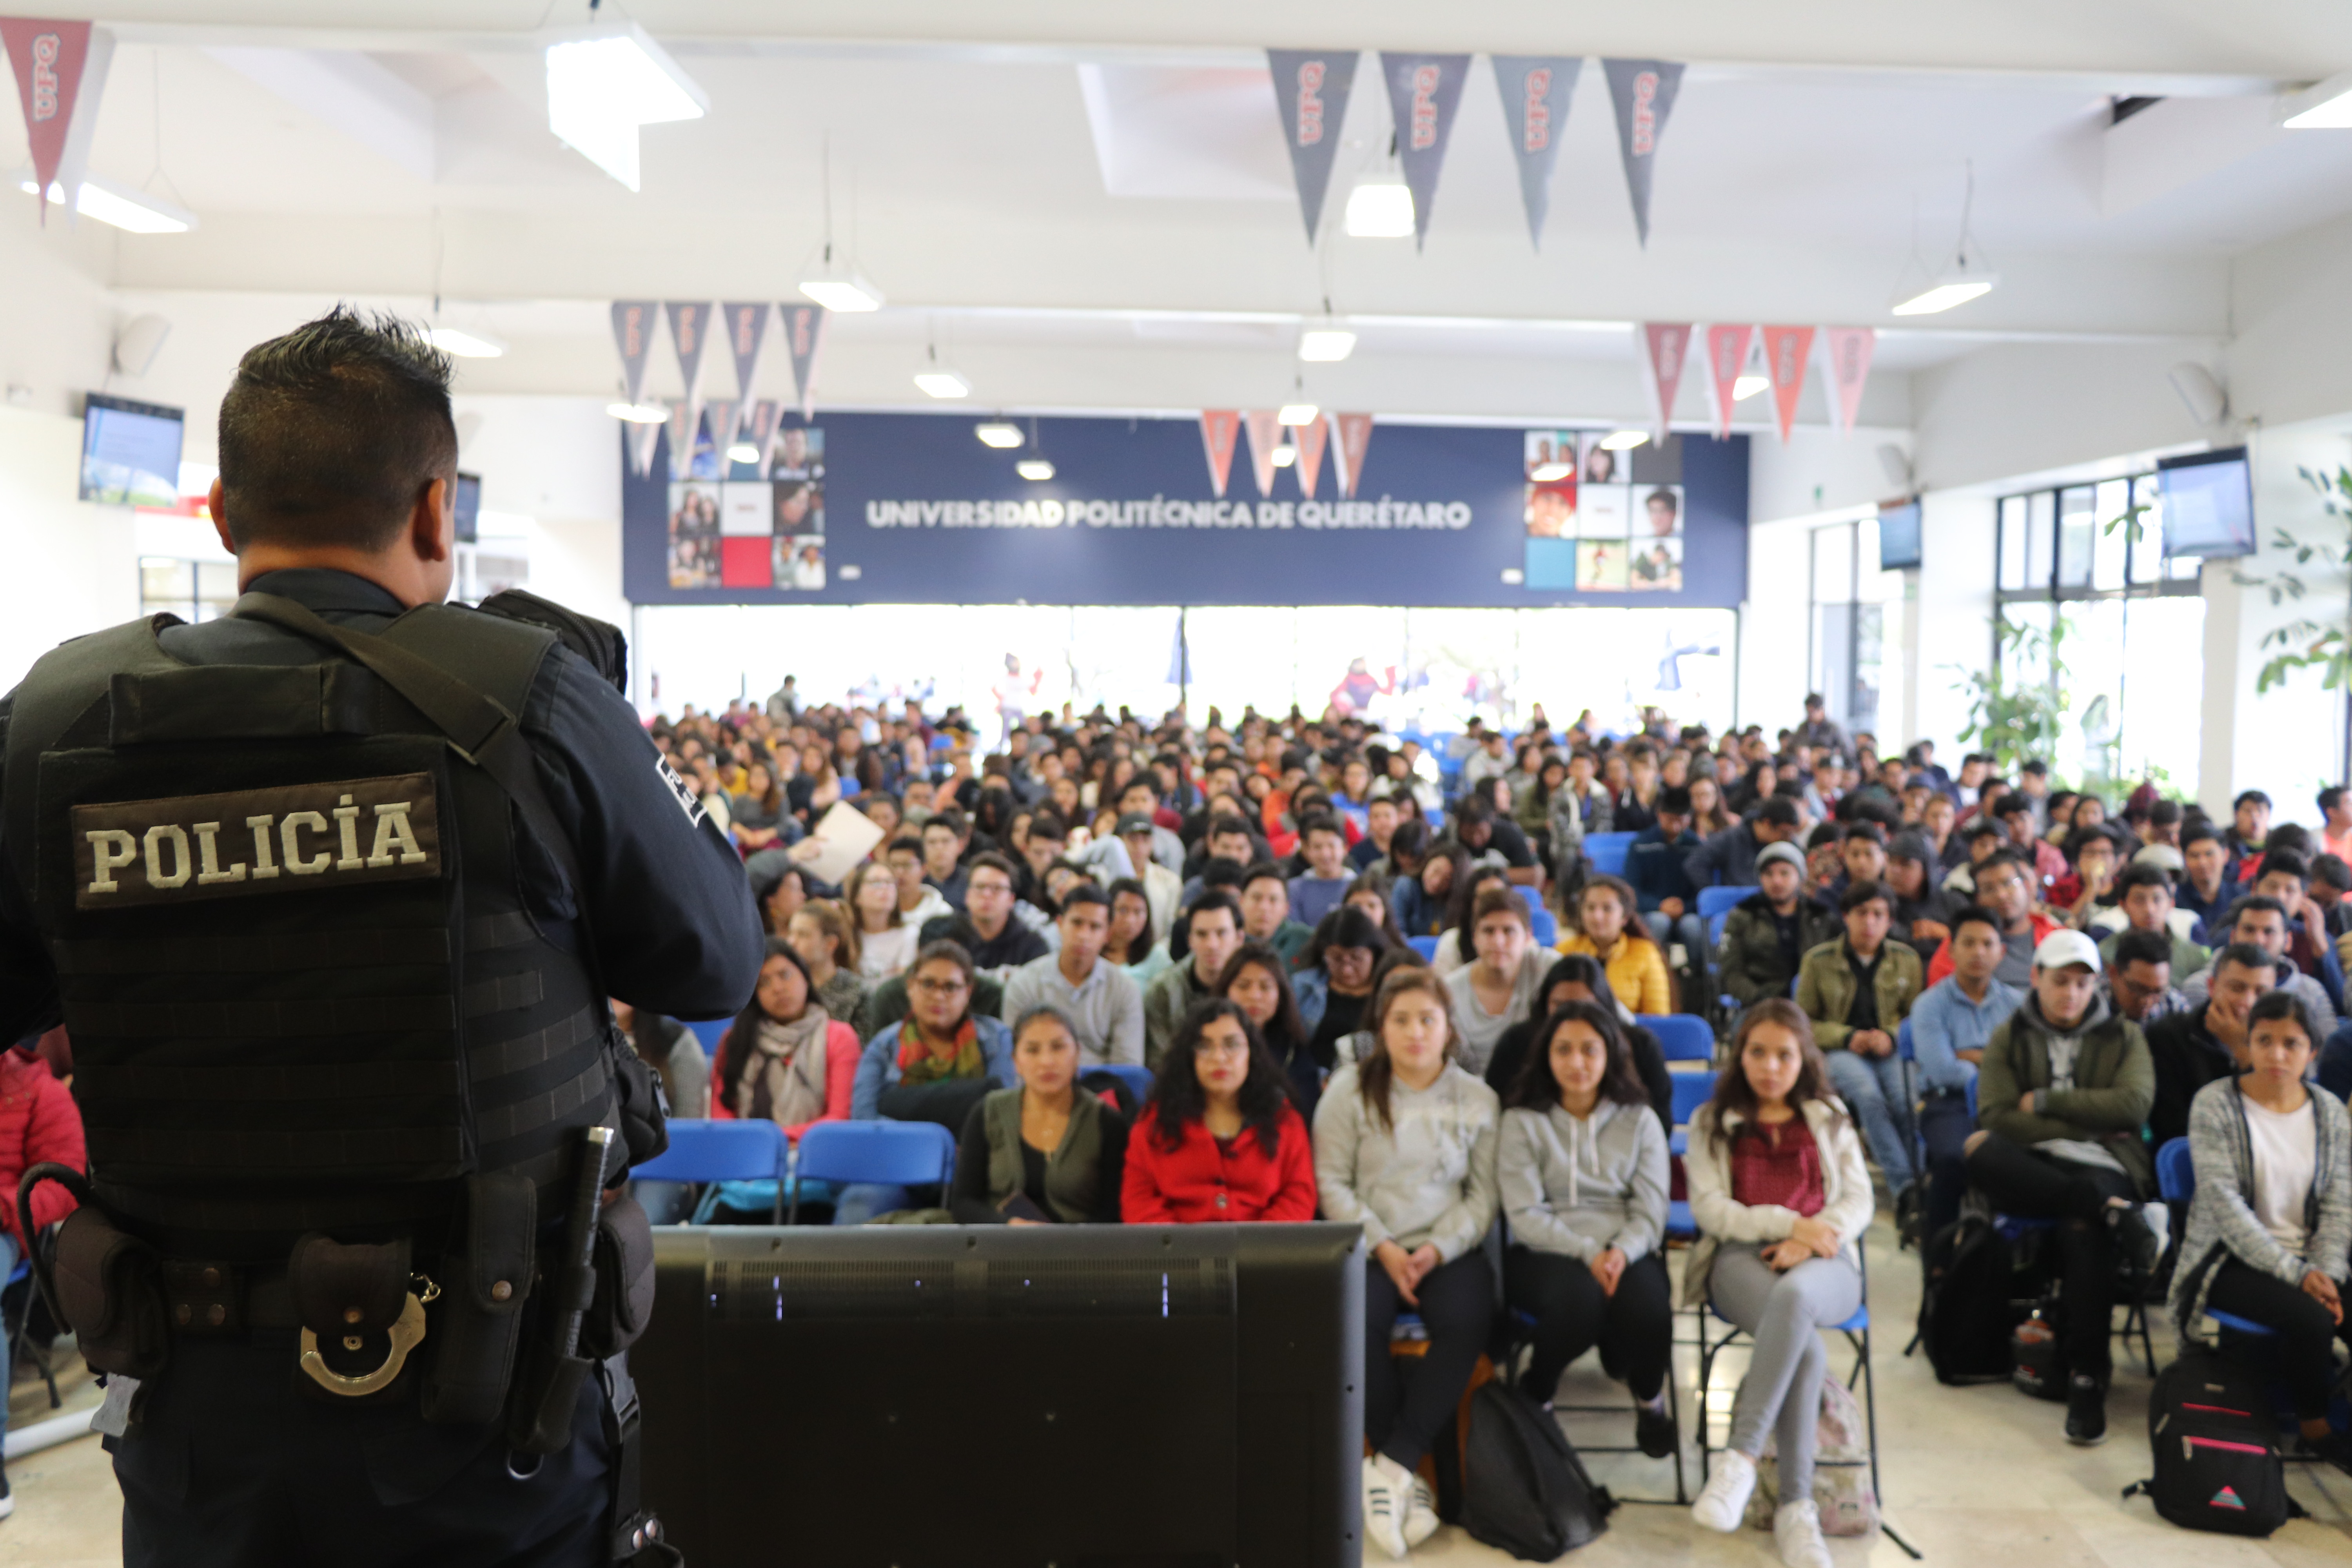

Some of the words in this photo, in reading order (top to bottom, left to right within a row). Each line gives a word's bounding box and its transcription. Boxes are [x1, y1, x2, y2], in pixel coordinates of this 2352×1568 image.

[31, 32, 61, 122] UPQ
[1298, 61, 1327, 146] UPQ
[1411, 64, 1440, 151] UPQ
[1524, 67, 1552, 153] UPQ
[1632, 71, 1659, 156] UPQ
[866, 500, 1064, 528] UNIVERSIDAD
[1066, 493, 1253, 528] POLITÉCNICA
[1257, 501, 1294, 528] DE
[1297, 494, 1472, 529] QUERÉTARO
